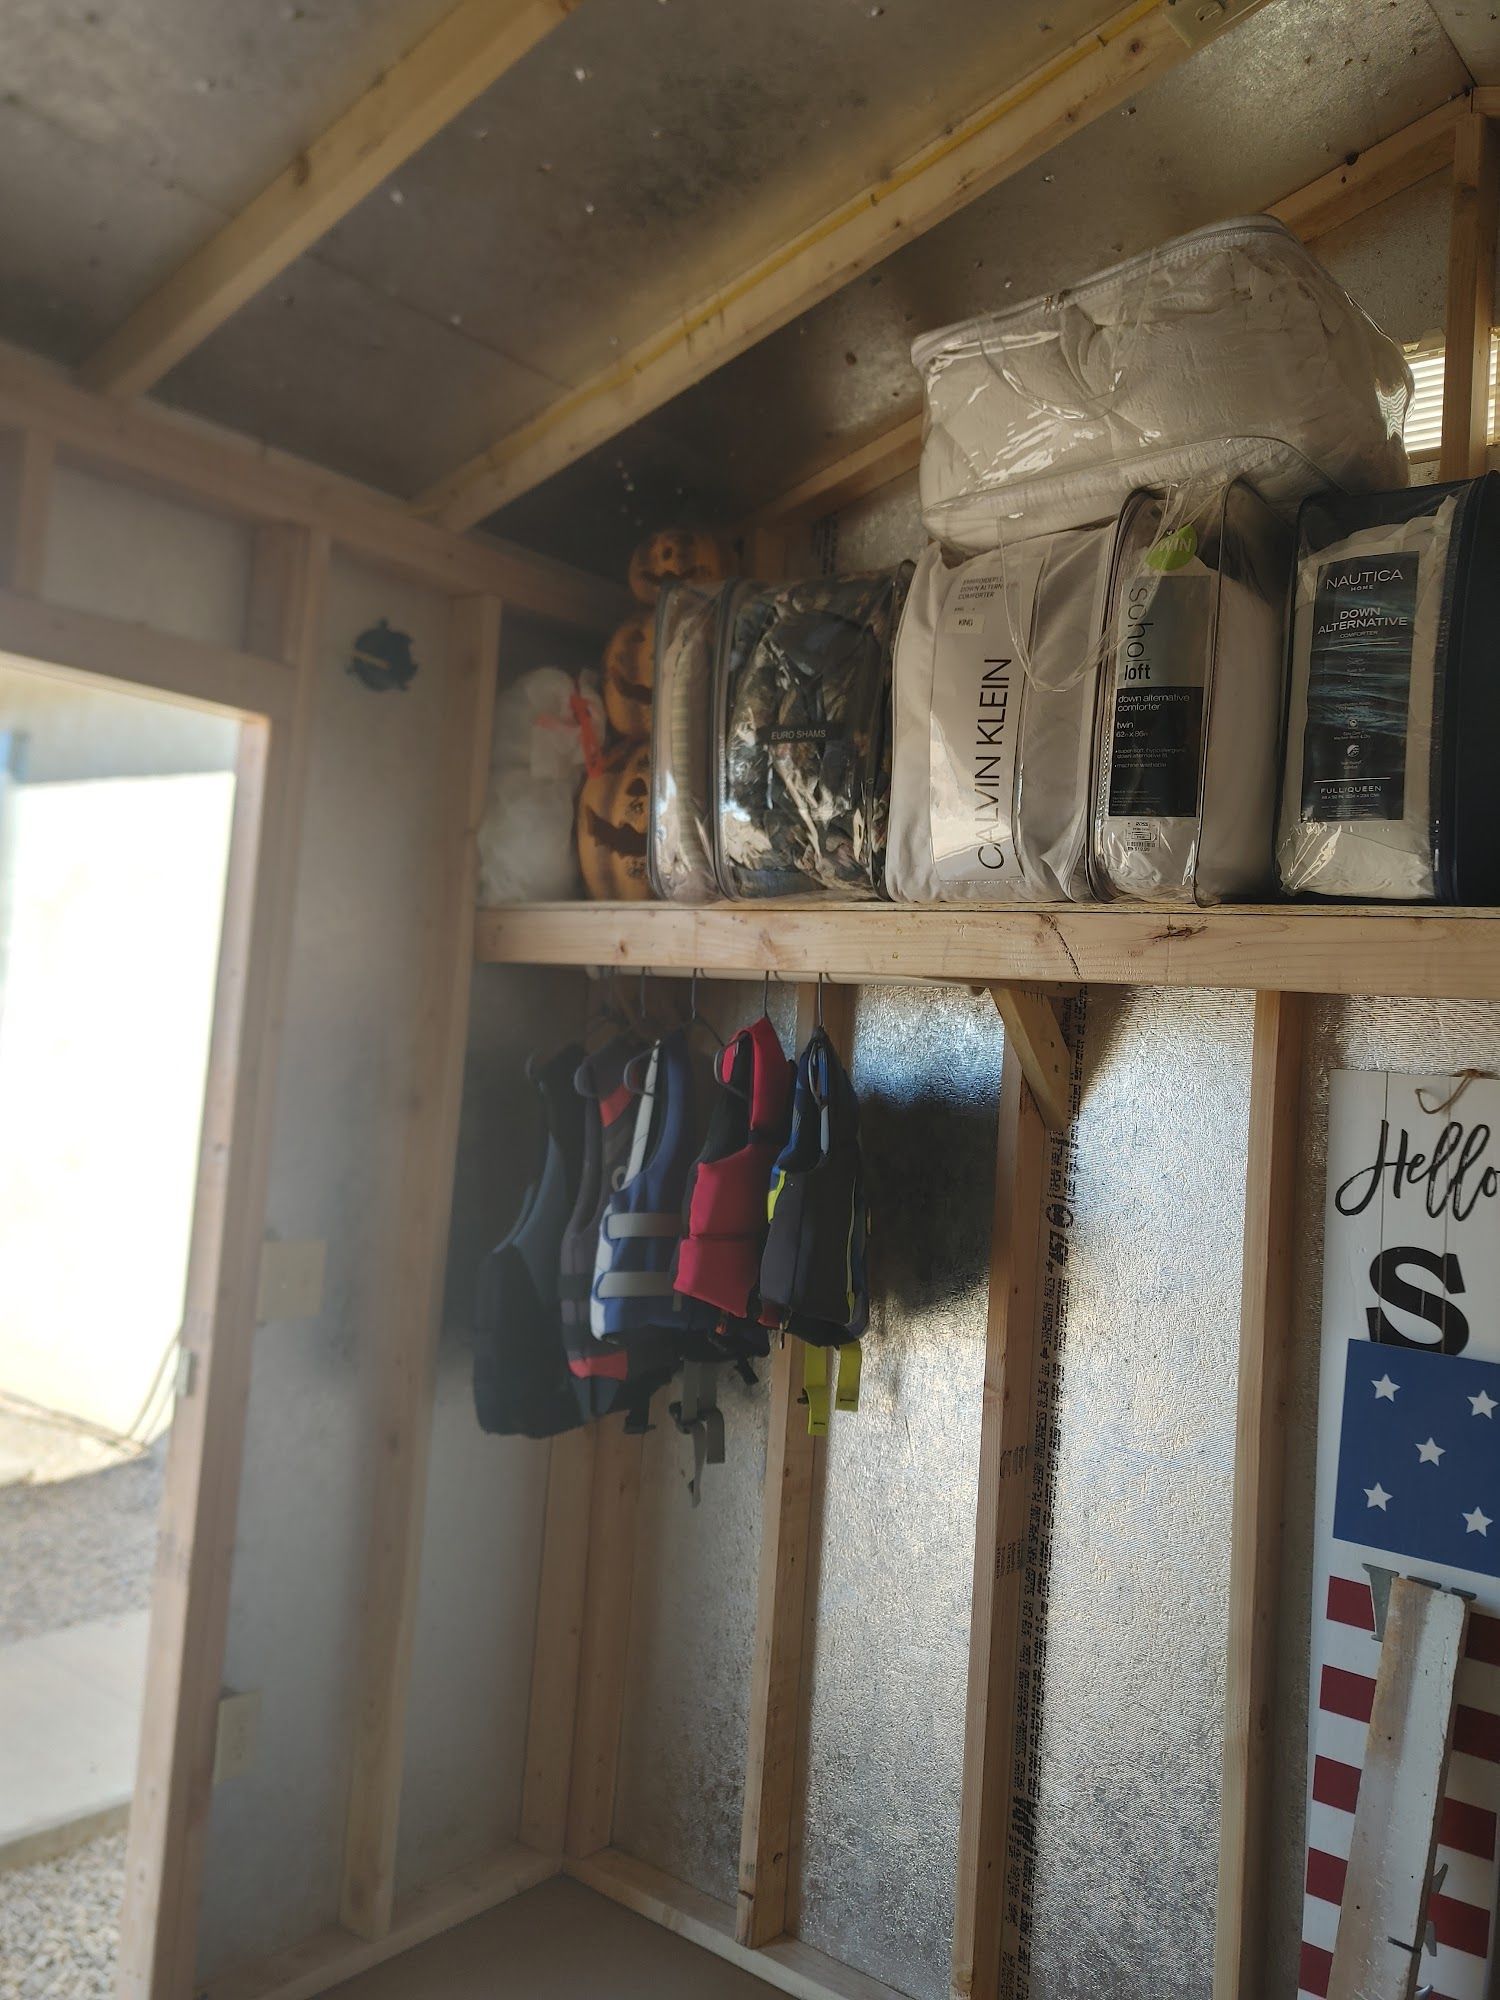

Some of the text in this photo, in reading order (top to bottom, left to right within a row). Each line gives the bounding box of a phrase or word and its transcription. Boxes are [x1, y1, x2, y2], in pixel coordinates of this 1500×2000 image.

[1326, 569, 1404, 589] NAUTICA
[1350, 584, 1374, 592] HOME
[1340, 607, 1381, 620] DOWN
[1317, 616, 1409, 635] ALTERNATIVE
[1339, 630, 1379, 639] COMFORTER
[1124, 664, 1151, 681] loft
[1118, 693, 1190, 704] down alternative
[1117, 703, 1161, 712] comforter
[1116, 720, 1134, 730] twin
[771, 729, 826, 740] EURO SHAMS
[974, 659, 1012, 869] CALVIN KLEIN
[1335, 1120, 1500, 1222] Hello
